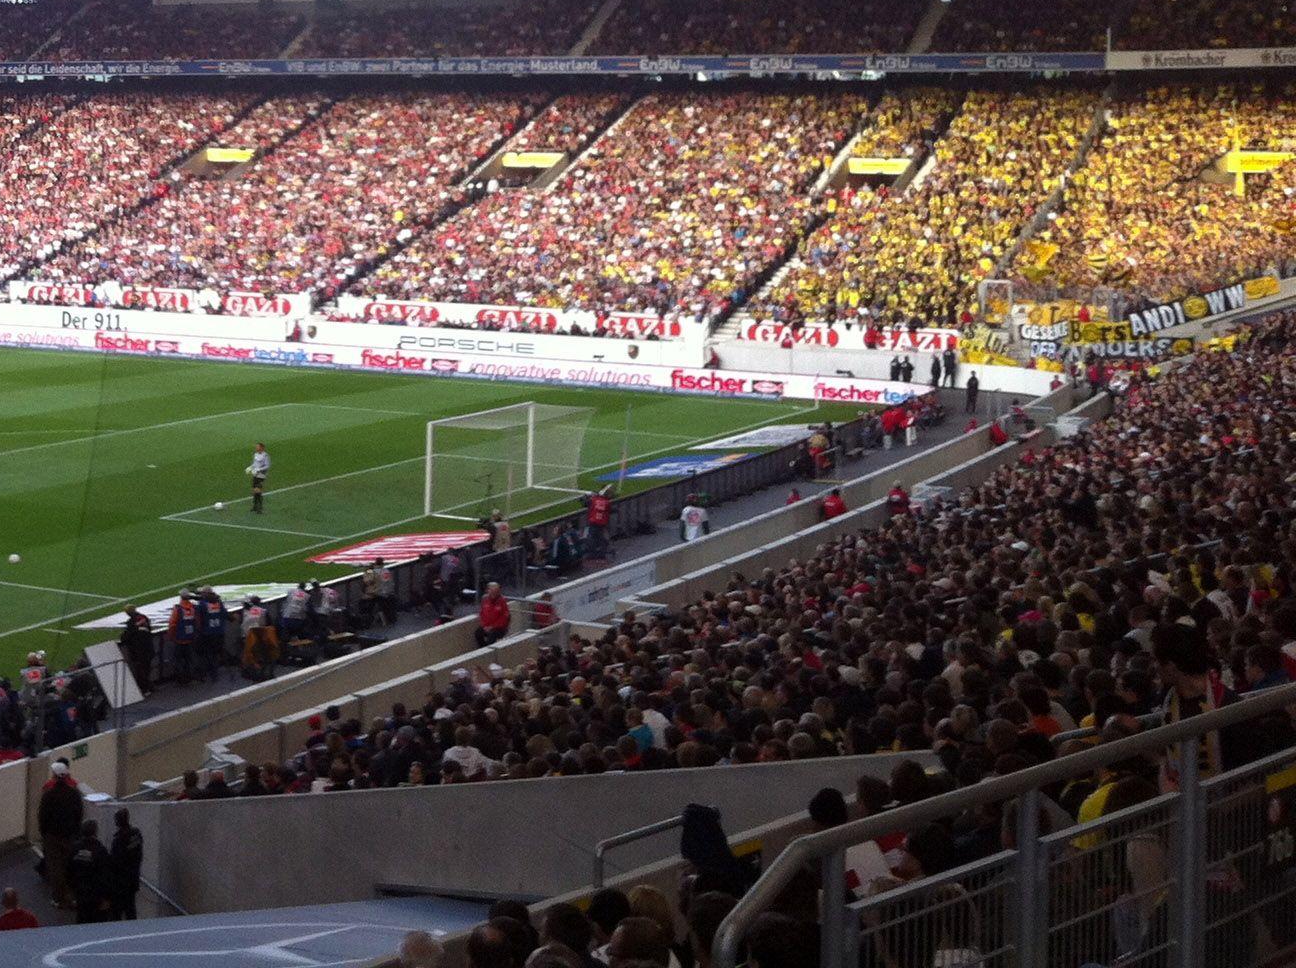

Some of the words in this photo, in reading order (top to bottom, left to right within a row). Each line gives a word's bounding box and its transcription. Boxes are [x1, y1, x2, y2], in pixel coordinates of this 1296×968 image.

[8, 64, 27, 74] seid
[28, 64, 43, 74] die
[108, 64, 125, 74] wir
[126, 64, 141, 74] die
[393, 60, 433, 72] Partner
[438, 60, 454, 71] für
[458, 61, 478, 71] das
[1154, 53, 1226, 66] Krombacher
[32, 284, 88, 303] GAZI
[225, 294, 286, 316] GAZI
[62, 311, 87, 329] Der
[94, 313, 128, 332] 911.
[603, 317, 675, 337] GAZI
[17, 332, 81, 347] solutions
[95, 331, 151, 352] fischer
[400, 335, 535, 355] PORSCHE
[755, 325, 831, 346] GAZI
[202, 342, 309, 363] fischertechnik
[361, 349, 426, 369] fischer
[470, 361, 561, 380] innovative
[567, 366, 652, 387] solutions
[671, 369, 747, 393] fischer
